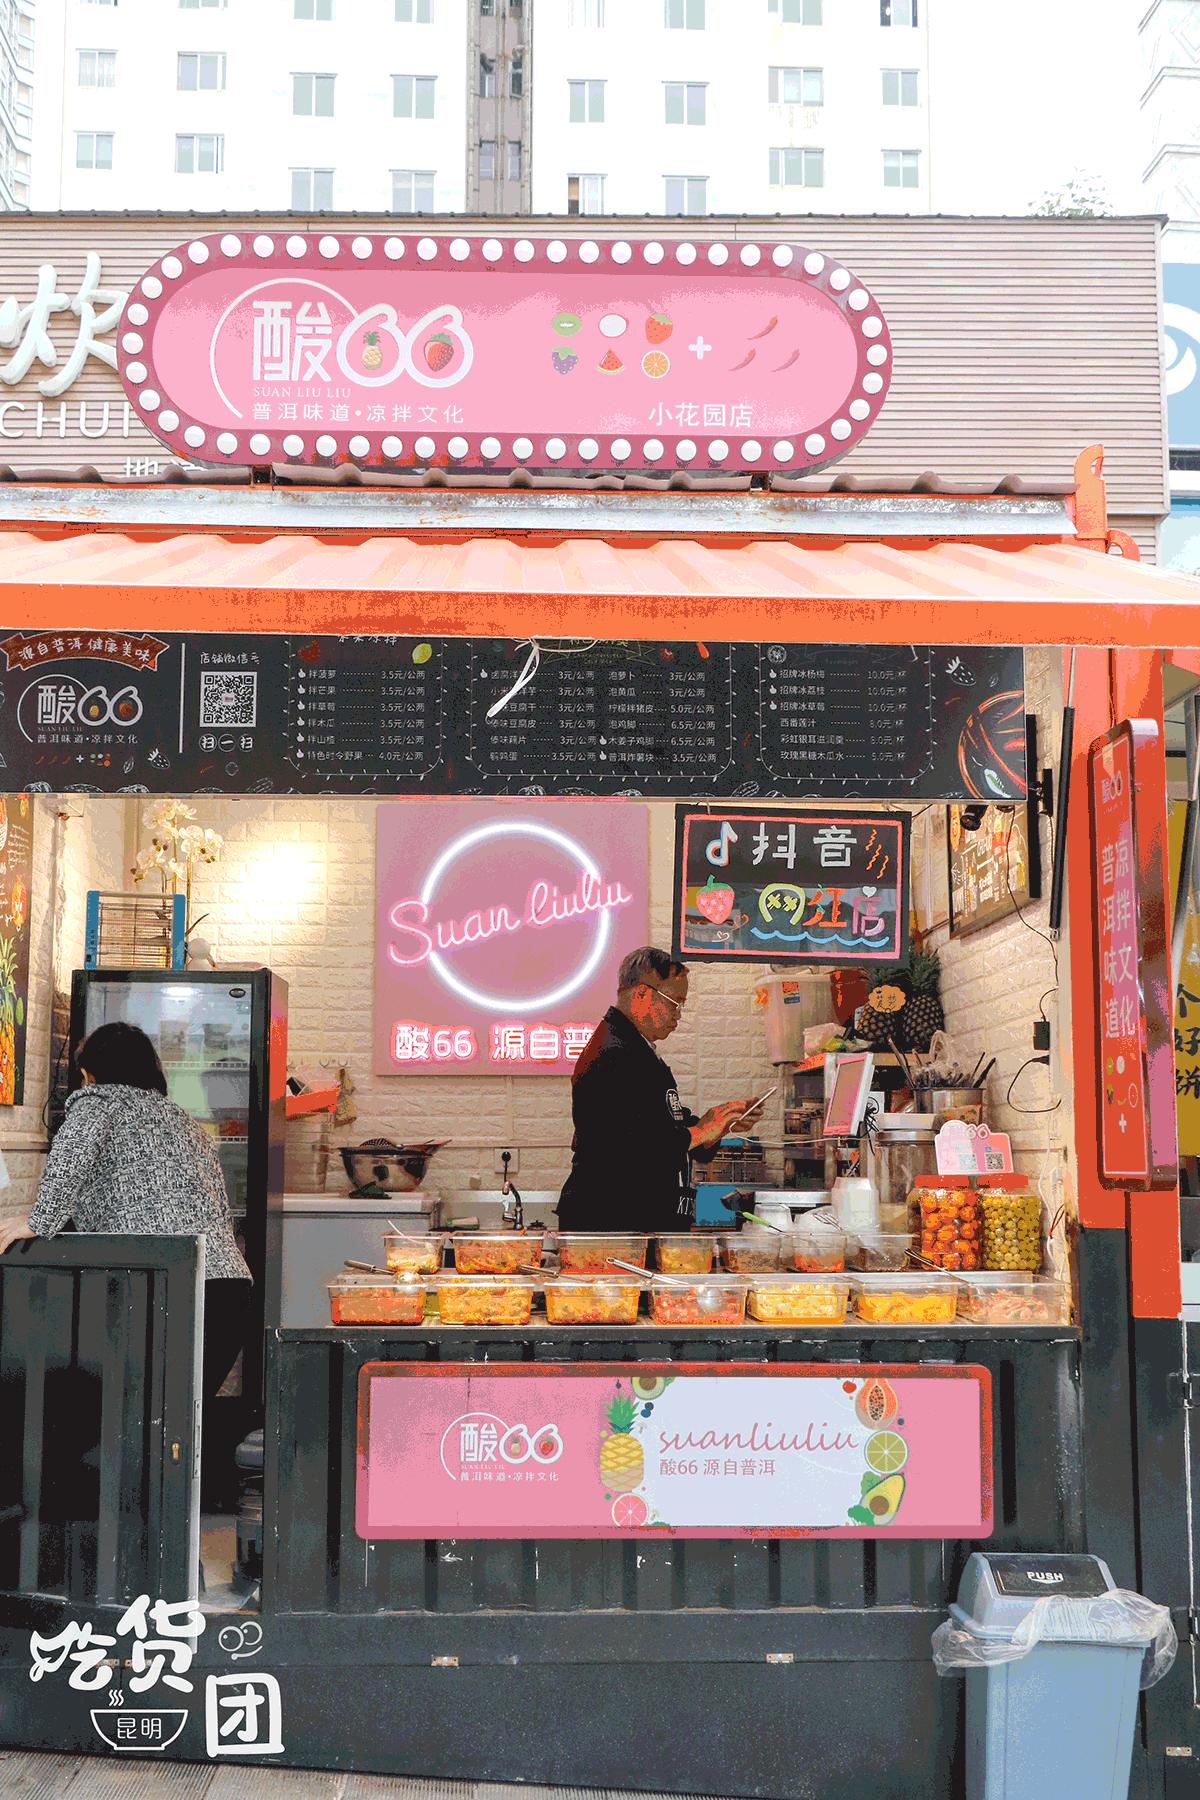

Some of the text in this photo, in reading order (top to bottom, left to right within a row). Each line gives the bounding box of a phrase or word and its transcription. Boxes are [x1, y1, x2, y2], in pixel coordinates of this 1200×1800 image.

[252, 300, 474, 388] 酸66
[253, 387, 352, 398] SUAN LIU LIU
[252, 401, 464, 424] 普洱味道·凉拌文化
[649, 402, 753, 429] 小花园店
[381, 671, 425, 679] 3.5元/公两
[559, 671, 594, 679] 3元/公两
[669, 672, 705, 681] 3元/公两
[381, 687, 425, 695] 3.5元/公两
[559, 687, 594, 696] 3元/公两
[669, 689, 705, 697] 3元/公两
[381, 703, 424, 712] 3.5元/公两
[559, 704, 594, 712] 3元/公两
[671, 705, 714, 714] 5.0元/公两
[308, 719, 424, 728] 拌木瓜 3.5元/公两
[559, 720, 595, 728] 3元/公两
[671, 721, 715, 730] 6.5元/公两
[200, 734, 254, 751] 扫一扫
[380, 736, 424, 744] 3.5元/公两
[560, 736, 596, 745] 3元/公两
[671, 738, 715, 746] 6.5元/公两
[379, 752, 423, 761] 4.0元/公两
[552, 752, 596, 761] 3.5元/公两
[672, 753, 716, 763] 3.5元/公两
[752, 822, 858, 869] 抖音
[758, 882, 886, 938] 网红店
[389, 899, 521, 965] Suan
[1101, 842, 1121, 1040] 普洱味道
[1115, 839, 1135, 1038] 凉拌文化
[395, 1025, 473, 1060] 酸66
[658, 1421, 860, 1453] suanliuliu
[460, 1423, 563, 1464] 酸66
[659, 1457, 777, 1477] 酸66 源自普洱
[1027, 1571, 1064, 1580] PUSH
